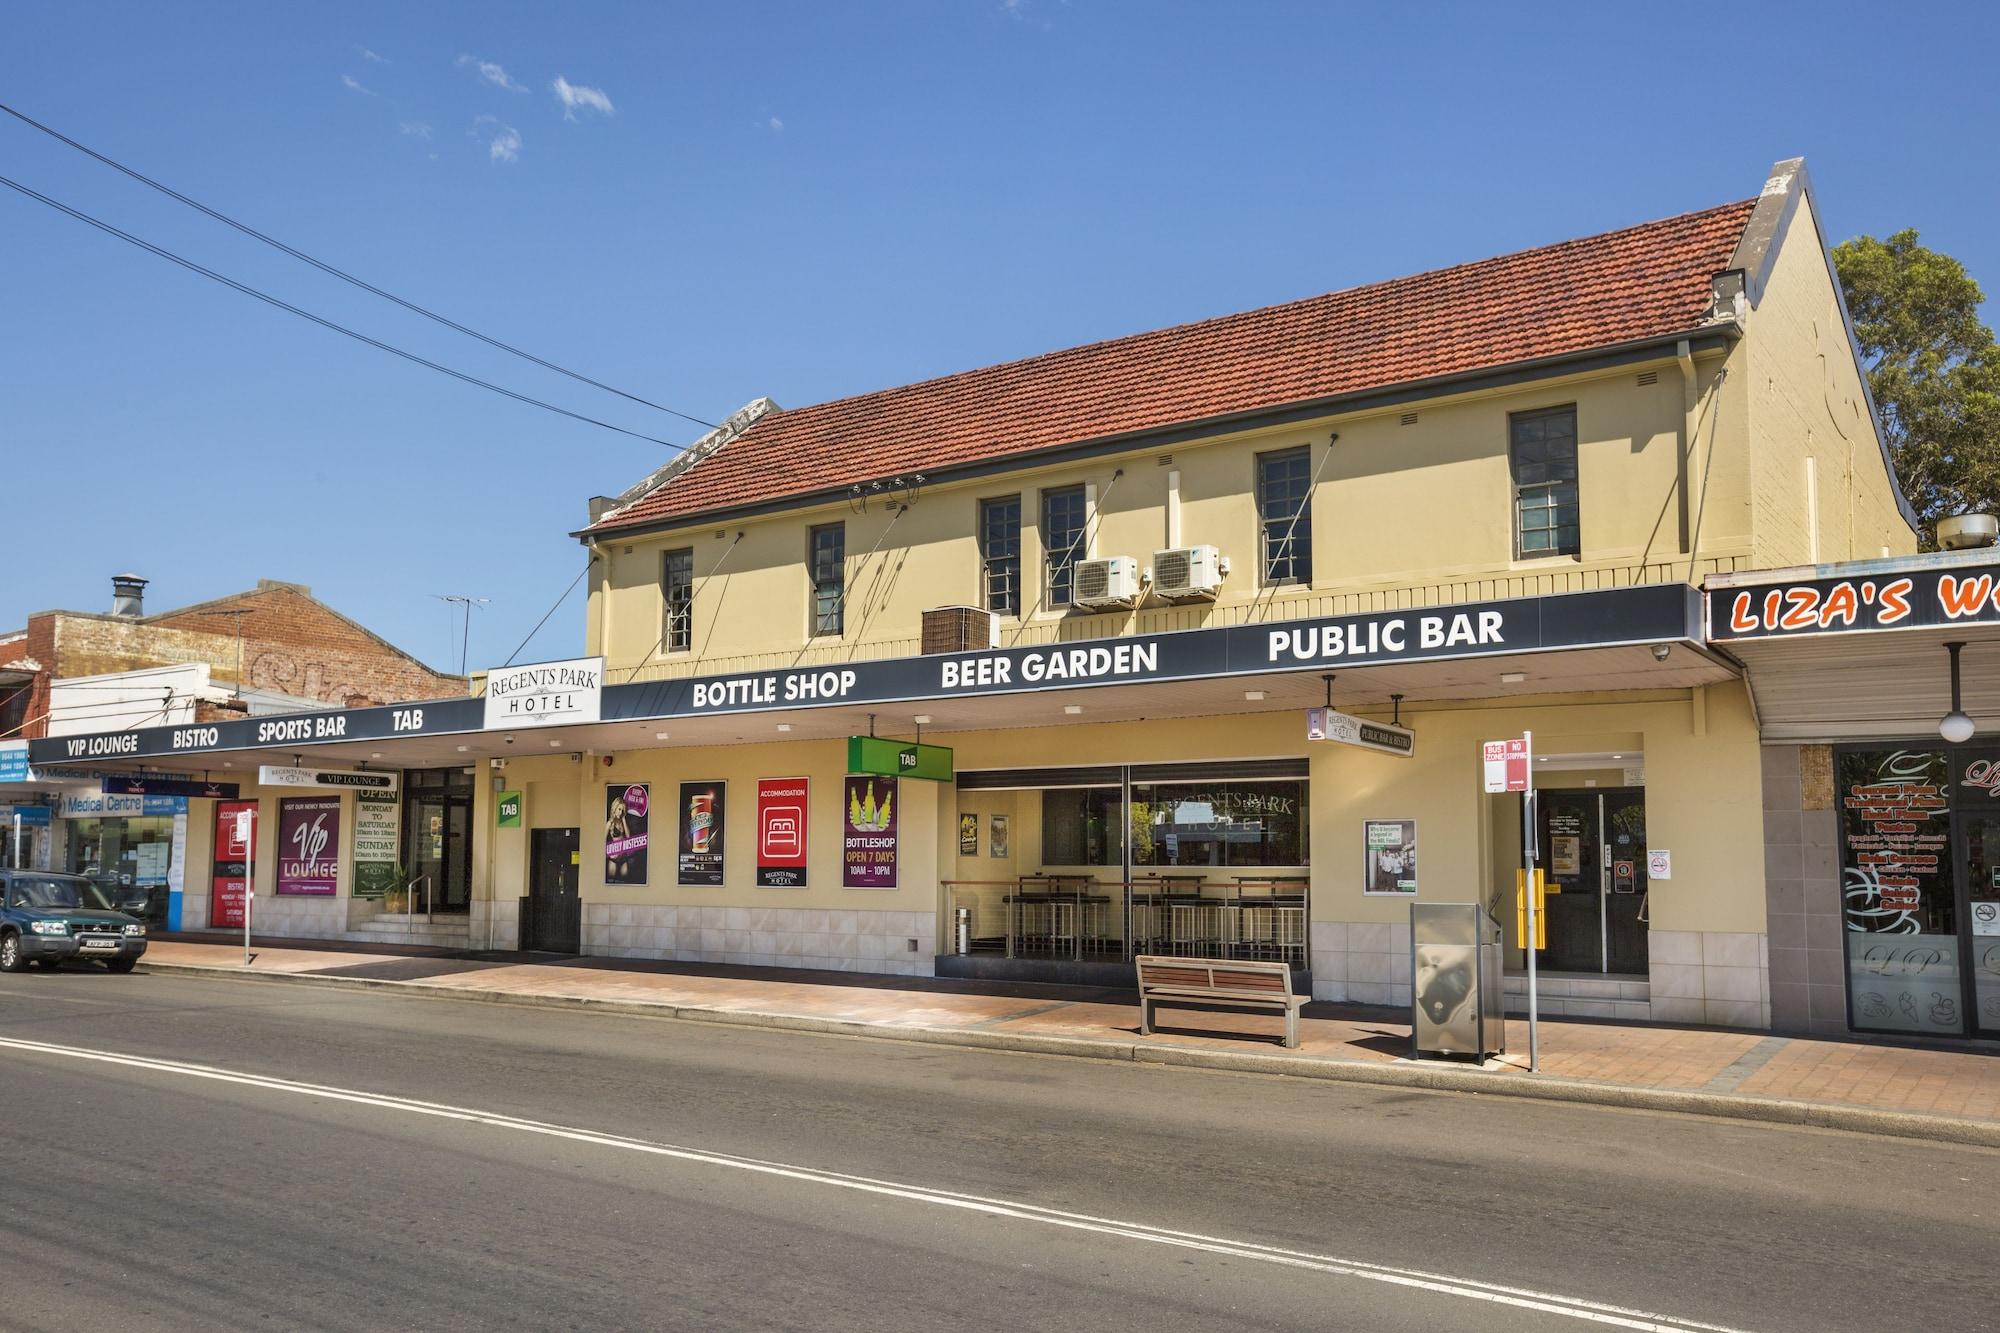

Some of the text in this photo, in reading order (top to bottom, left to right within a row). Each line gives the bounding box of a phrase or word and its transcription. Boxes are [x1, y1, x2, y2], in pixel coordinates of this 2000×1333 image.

[1731, 574, 2000, 632] LIZA'S W
[1269, 611, 1504, 661] PUBLIC BAR
[942, 643, 1158, 688] BEER GARDEN
[491, 668, 597, 698] REGENTS PARK
[693, 670, 856, 708] BOTTLE SHOP
[510, 694, 573, 713] HOTEL
[393, 709, 423, 731] TAB
[258, 716, 346, 742] SPORTS BAR
[173, 727, 218, 748] BISTRO
[1361, 728, 1379, 740] PUBLIC
[1380, 732, 1390, 743] BAR
[1394, 735, 1410, 748] BISTRO
[67, 734, 138, 756] VIP LOUNGE
[1487, 746, 1502, 754] BUS
[1511, 742, 1522, 751] NO
[900, 753, 916, 766] TAB
[1486, 753, 1504, 761] ZONE
[327, 774, 381, 785] VIP LOUNGE
[360, 789, 396, 799] OPEN
[760, 789, 805, 798] ACCOMMODATION
[68, 796, 104, 812] Medical
[107, 795, 141, 811] Centre
[501, 804, 517, 815] TAB
[1248, 792, 1294, 814] PARK
[358, 821, 396, 829] SATURDAY
[292, 813, 329, 869] Vip
[357, 841, 395, 850] SUNDAY
[606, 841, 622, 855] LOVELY
[846, 838, 896, 848] BOTTLESHOP
[847, 851, 895, 862] OPEN 7 DAYS
[284, 863, 337, 877] LOUNGE
[850, 866, 867, 875] 10AM
[874, 866, 890, 875] 10PM
